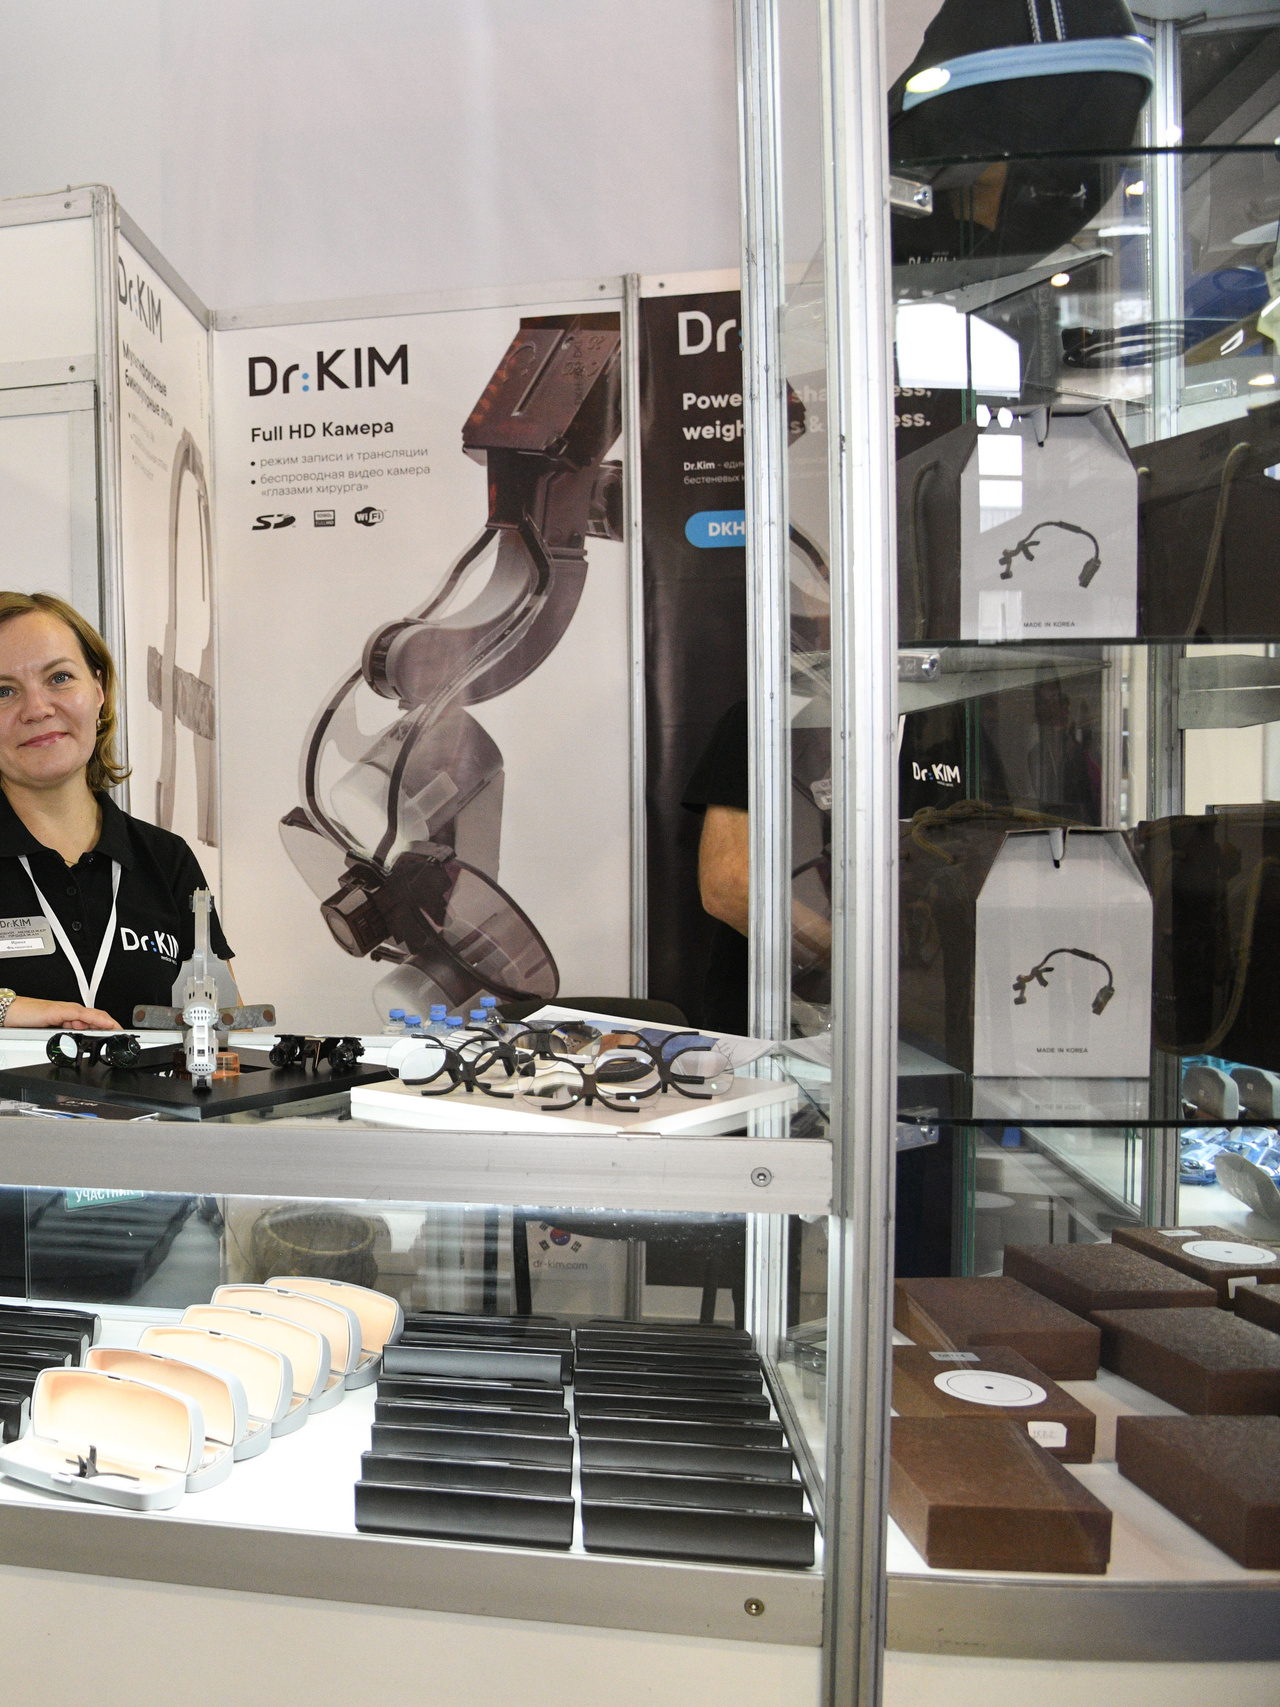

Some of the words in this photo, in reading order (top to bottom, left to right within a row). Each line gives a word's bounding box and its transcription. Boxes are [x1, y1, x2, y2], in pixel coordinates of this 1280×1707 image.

[683, 393, 743, 411] Powe
[251, 426, 283, 443] Full
[289, 423, 316, 440] HD
[322, 421, 394, 438] Камера
[682, 419, 745, 442] weigh
[260, 457, 299, 468] режим
[301, 453, 343, 465] записи
[346, 452, 354, 461] и
[357, 448, 428, 462] трансляции
[683, 460, 716, 471] Dr.Kim
[260, 470, 345, 485] беспроводная
[348, 467, 384, 480] видео
[386, 465, 431, 477] камера
[683, 475, 740, 485] бестеневых
[708, 521, 746, 536] DKH
